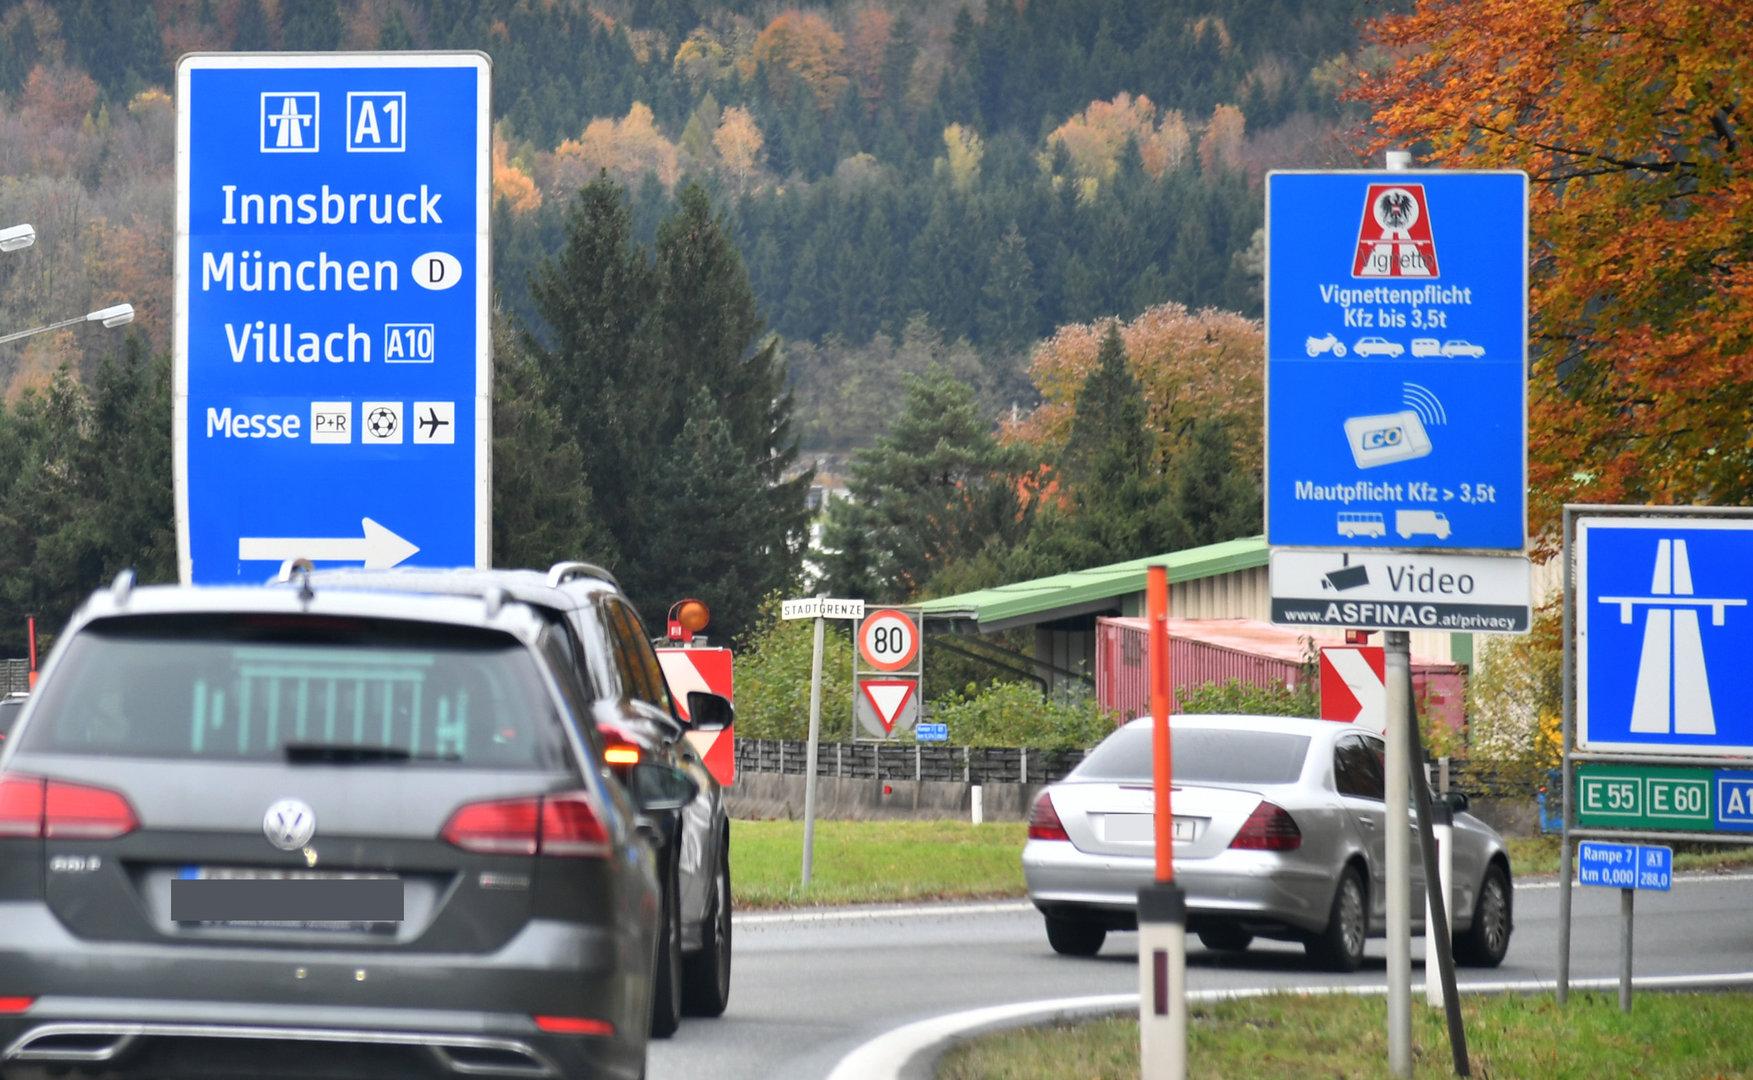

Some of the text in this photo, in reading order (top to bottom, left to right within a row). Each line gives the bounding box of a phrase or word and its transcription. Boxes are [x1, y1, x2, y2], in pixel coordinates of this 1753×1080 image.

[354, 100, 400, 144] A1
[221, 184, 443, 225] Innsbruck
[202, 250, 398, 292] München
[428, 258, 445, 283] D
[1319, 283, 1472, 308] Vignettenpflicht
[1344, 308, 1448, 330] Kfz bis 3,5t
[224, 320, 371, 363] Villach
[387, 328, 433, 359] A10
[206, 407, 301, 439] Messe
[315, 414, 347, 432] P+R
[1295, 481, 1403, 505] Mautpflicht
[1408, 482, 1438, 501] Kfz
[1460, 484, 1496, 505] 3,5t
[1386, 563, 1475, 595] Video
[784, 603, 862, 616] STADTGRENZE
[1284, 602, 1516, 630] www.ASFINAG.at/privacy
[874, 626, 903, 654] 80
[1584, 846, 1633, 865] Rampe 7
[1582, 866, 1634, 885] km 0,000
